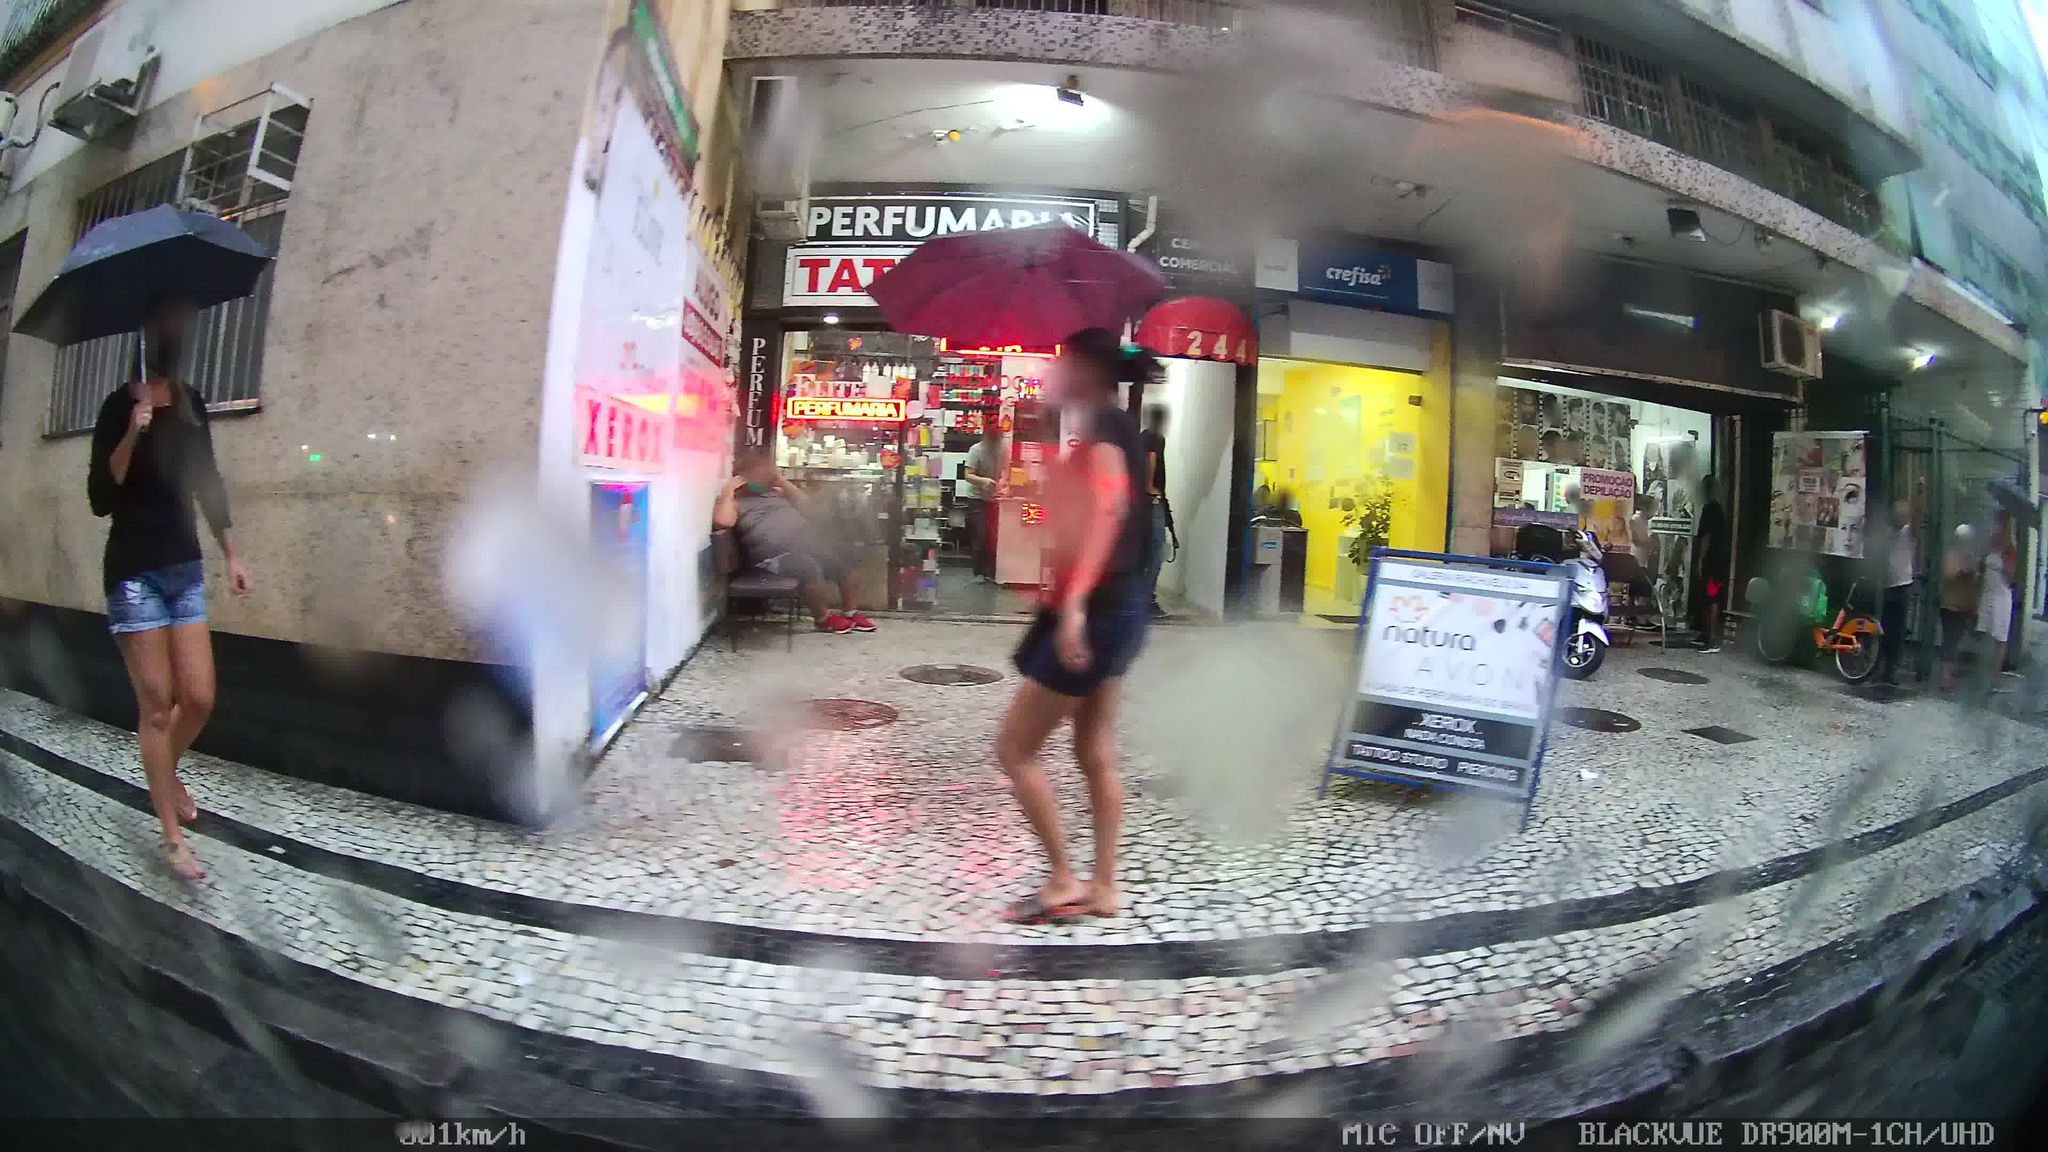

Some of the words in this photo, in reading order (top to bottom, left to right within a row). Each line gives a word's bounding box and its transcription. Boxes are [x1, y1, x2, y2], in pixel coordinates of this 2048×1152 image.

[1326, 267, 1382, 286] crefisa
[794, 401, 899, 418] PERFUMARIA
[1382, 624, 1477, 651] natura
[1416, 712, 1479, 733] XEROX
